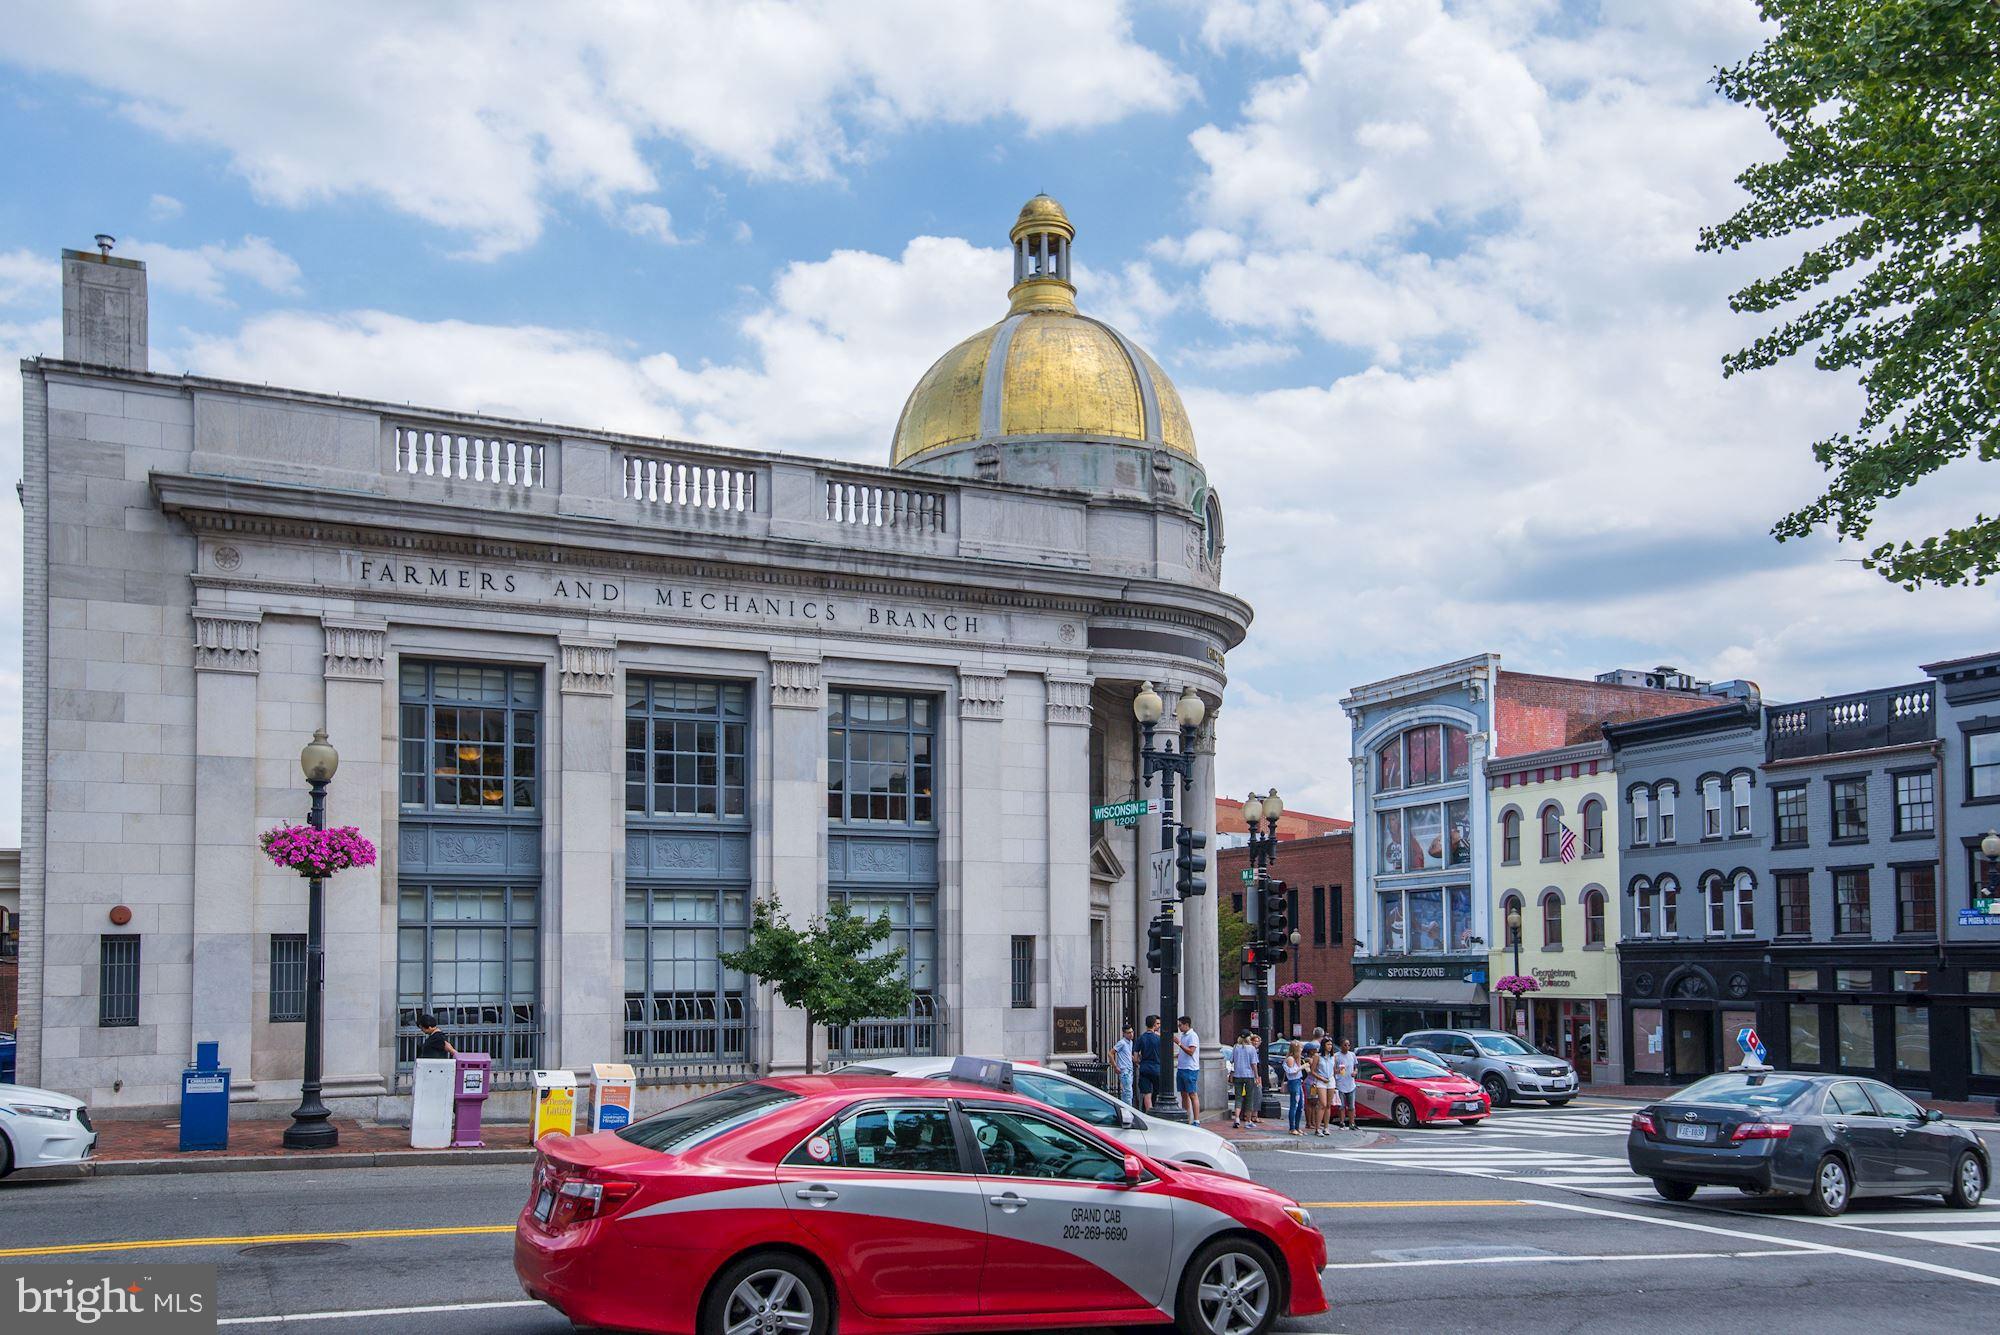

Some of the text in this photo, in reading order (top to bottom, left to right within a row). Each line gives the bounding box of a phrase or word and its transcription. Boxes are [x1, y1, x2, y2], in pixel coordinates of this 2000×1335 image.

[360, 561, 978, 633] FARMERS AND MECHANICS BRANCH
[1094, 803, 1139, 819] WISCONSIN
[1116, 816, 1136, 825] 1200
[1242, 870, 1248, 879] M
[1387, 967, 1420, 977] SPORTS
[1421, 967, 1445, 977] ZONE
[1531, 967, 1577, 979] Georgetown
[1539, 976, 1570, 987] Tobacco
[1065, 1019, 1081, 1027] PNC
[545, 1105, 572, 1118] Latino
[1071, 1207, 1121, 1223] GRAND CAB
[1063, 1224, 1128, 1241] 202-269-6690
